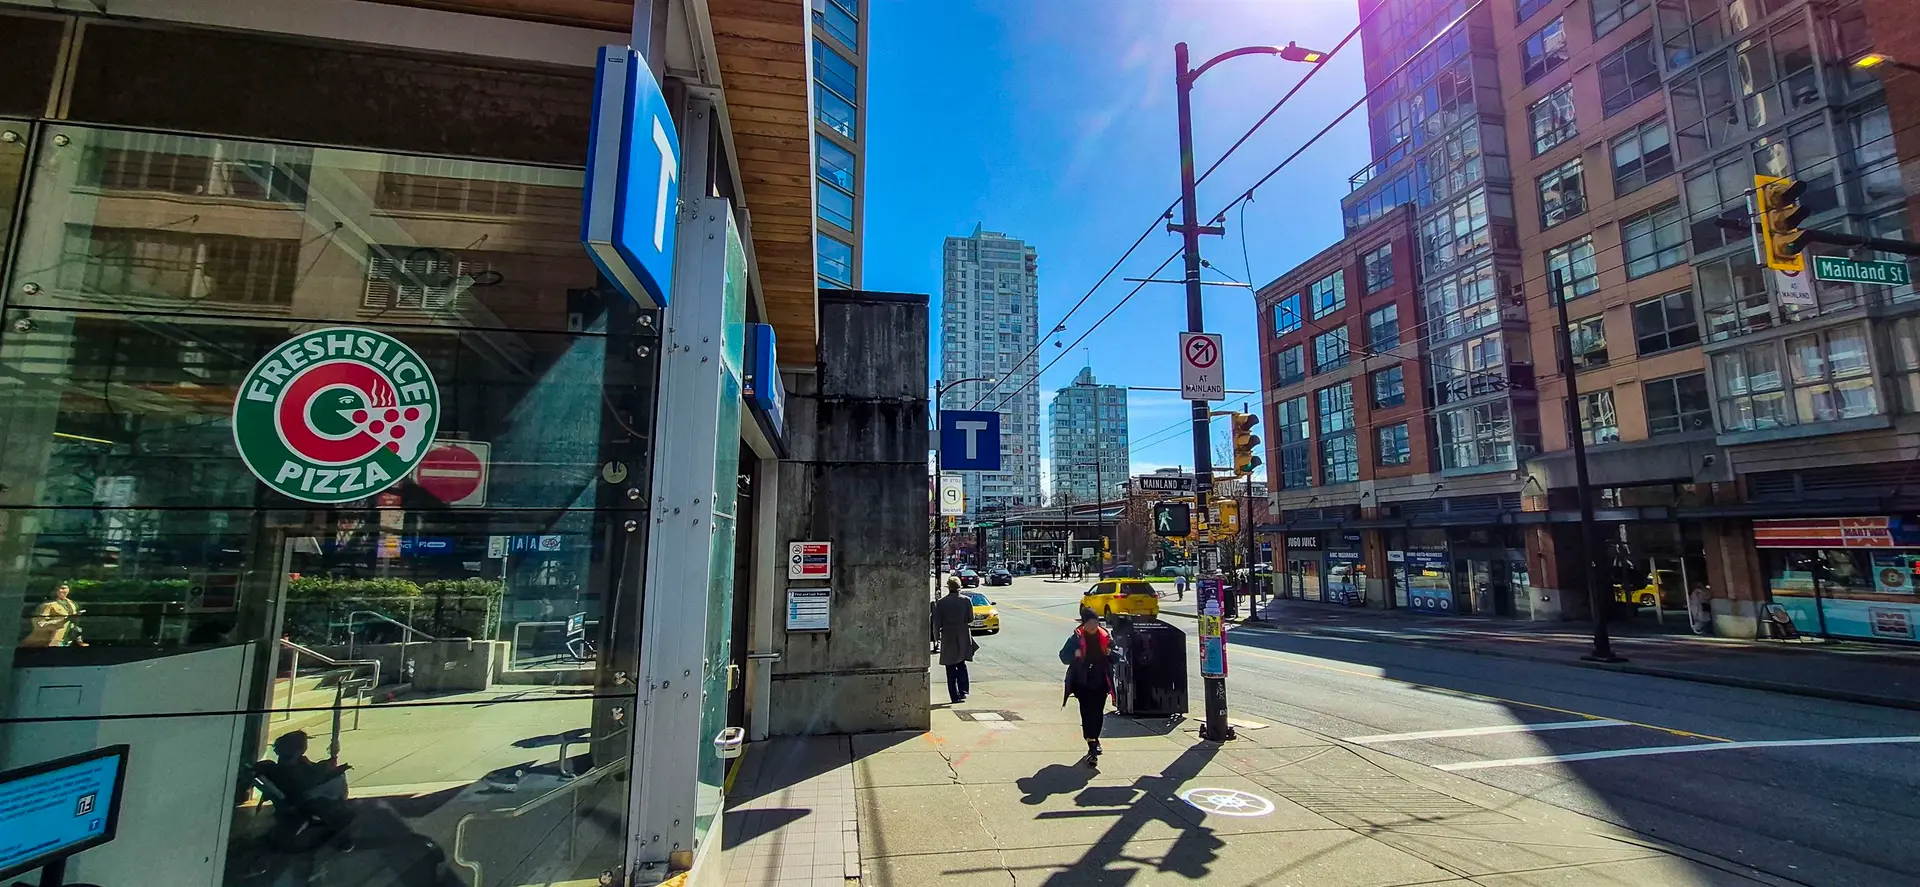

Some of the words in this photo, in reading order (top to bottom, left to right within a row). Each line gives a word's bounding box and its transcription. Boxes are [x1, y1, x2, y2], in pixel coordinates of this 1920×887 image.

[653, 113, 678, 253] T
[1822, 261, 1886, 280] Mainland
[1890, 266, 1904, 282] St
[246, 334, 430, 402] FRESHSLICE
[1199, 374, 1207, 382] AT
[1186, 384, 1221, 393] MAINLAND
[956, 421, 987, 459] T
[274, 460, 391, 494] PIZZA
[1143, 479, 1178, 489] MAINLAND
